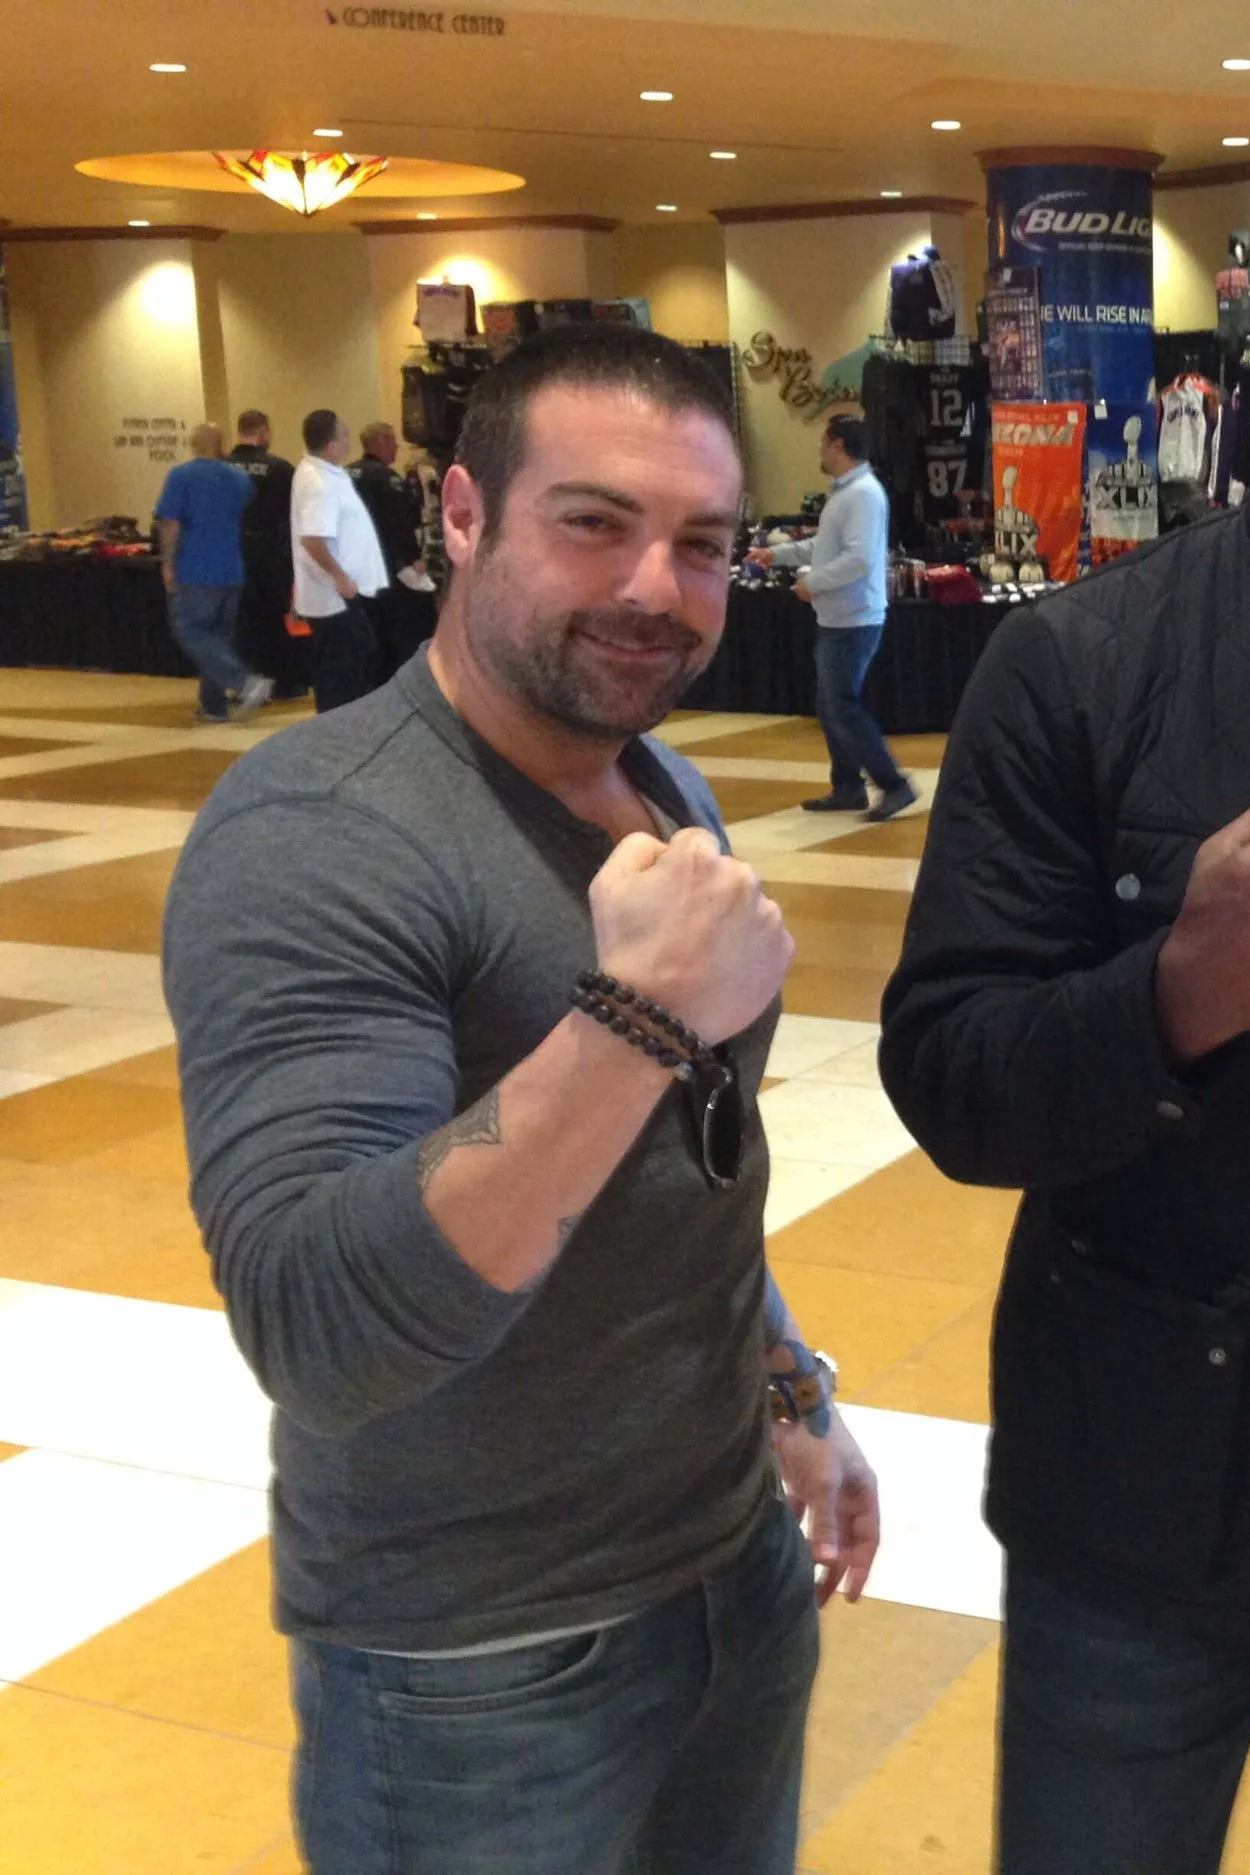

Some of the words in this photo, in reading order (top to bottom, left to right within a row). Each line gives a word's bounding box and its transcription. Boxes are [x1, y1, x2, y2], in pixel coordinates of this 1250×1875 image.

[1025, 208, 1109, 233] BUD
[1111, 211, 1152, 237] LIG
[1057, 305, 1093, 323] WILL
[1096, 306, 1127, 324] RISE
[1129, 307, 1140, 324] IN
[930, 388, 963, 427] 12
[927, 460, 967, 498] 87
